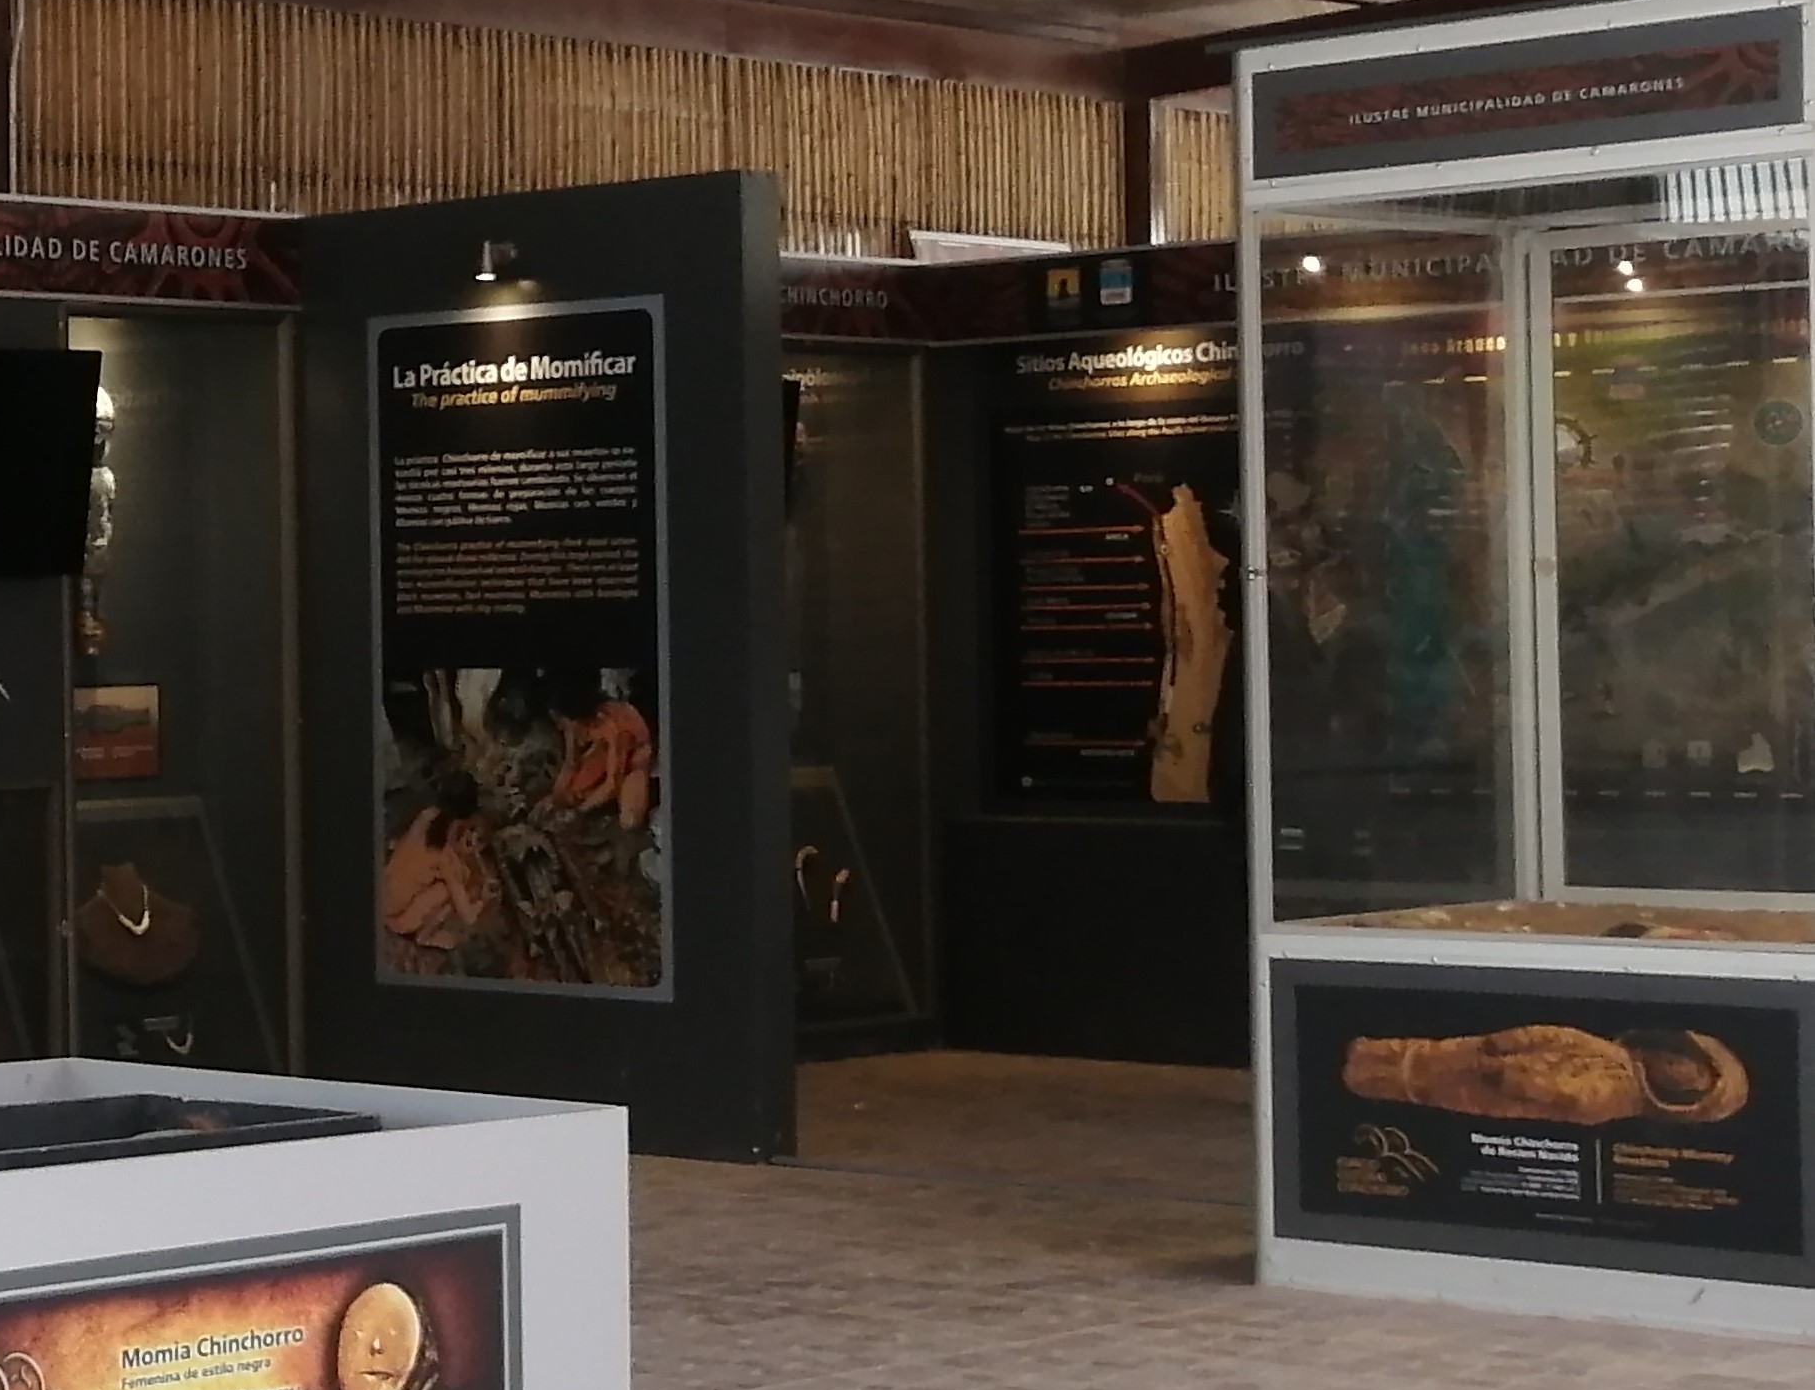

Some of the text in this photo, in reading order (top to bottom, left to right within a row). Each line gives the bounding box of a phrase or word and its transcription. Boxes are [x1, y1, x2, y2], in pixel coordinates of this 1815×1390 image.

[72, 237, 101, 262] DE
[109, 240, 248, 271] CAMARONES
[393, 351, 637, 389] La Práctica de Momificar
[121, 1328, 304, 1370] Momia Chinchorro
